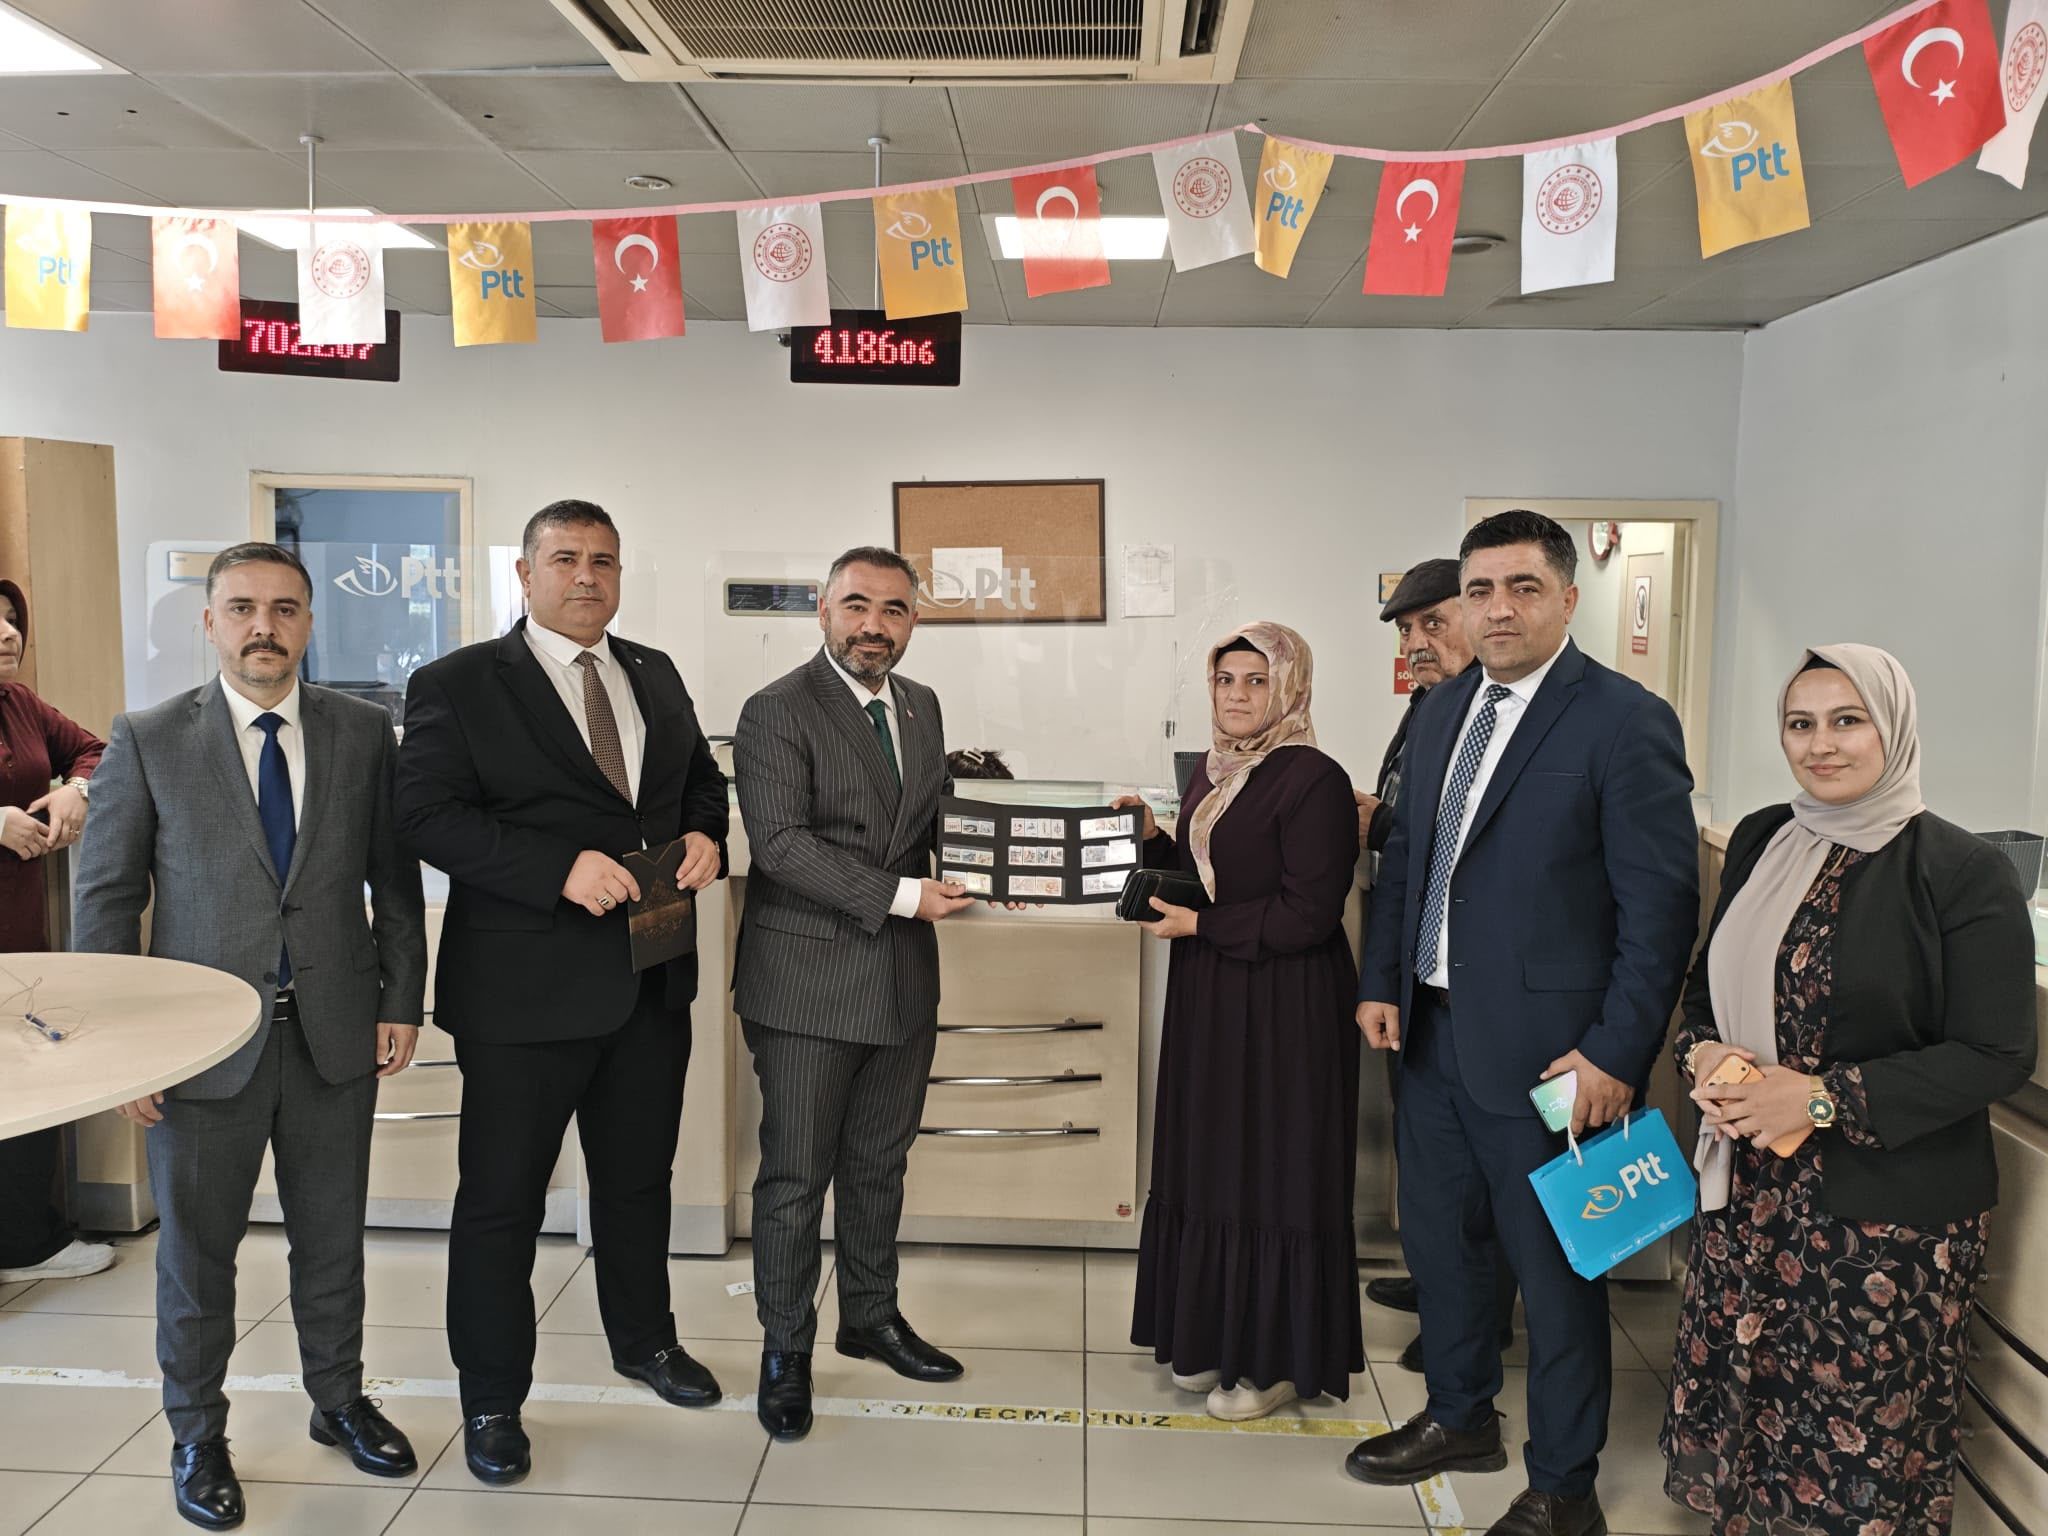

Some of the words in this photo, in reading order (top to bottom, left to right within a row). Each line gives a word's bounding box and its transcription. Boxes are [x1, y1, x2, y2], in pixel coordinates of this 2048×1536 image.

[1731, 142, 1790, 192] Ptt
[1266, 191, 1304, 229] Ptt
[39, 255, 78, 286] Ptt
[910, 237, 955, 271] Ptt
[481, 268, 525, 299] Ptt
[401, 555, 462, 600] Ptt
[974, 567, 1037, 611] Ptt
[1618, 1151, 1669, 1200] Ptt
